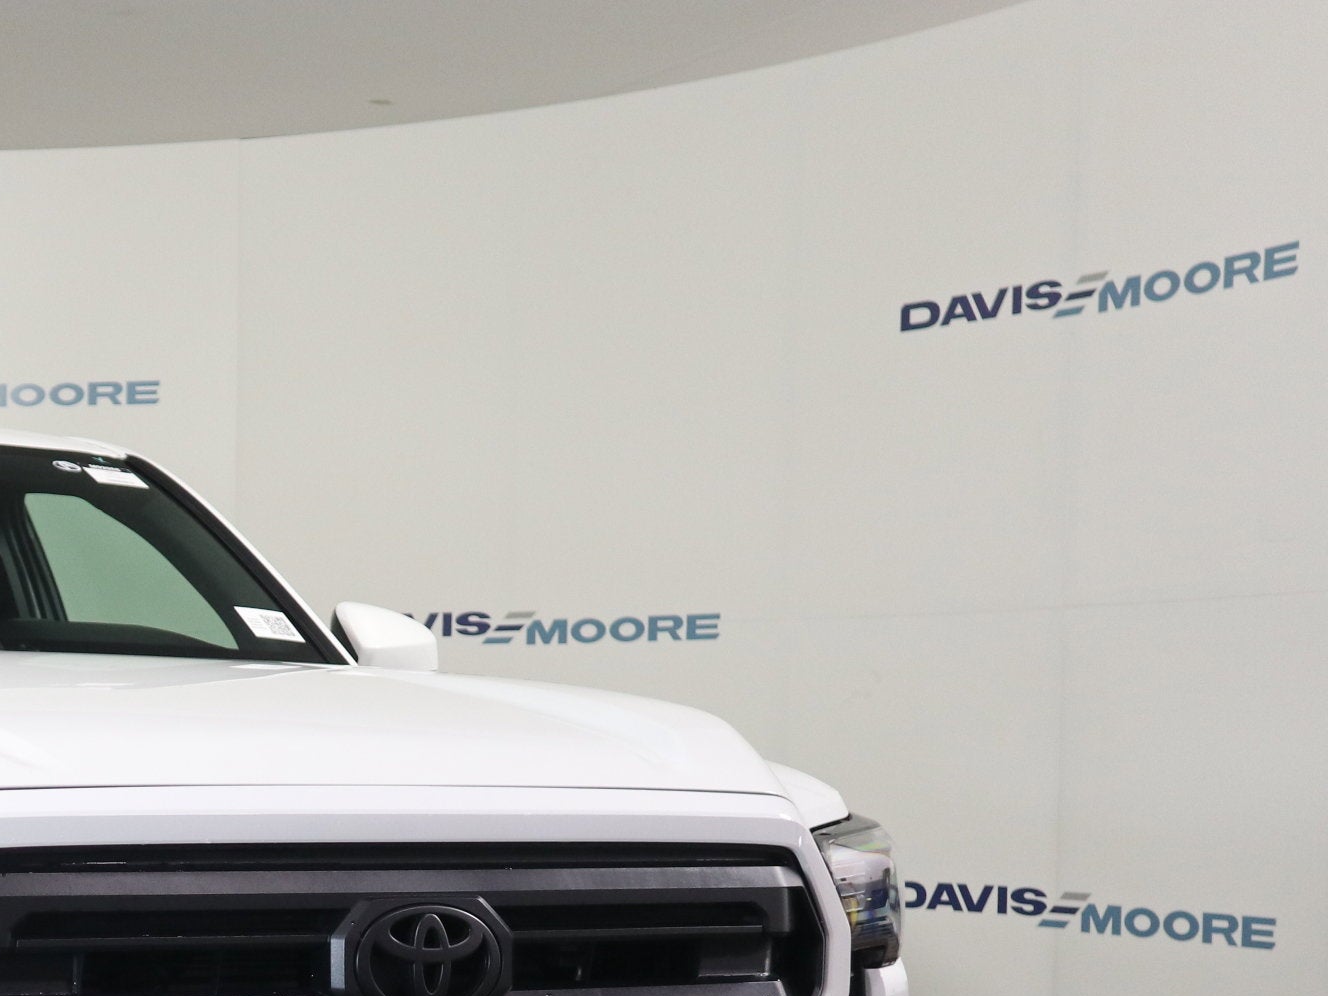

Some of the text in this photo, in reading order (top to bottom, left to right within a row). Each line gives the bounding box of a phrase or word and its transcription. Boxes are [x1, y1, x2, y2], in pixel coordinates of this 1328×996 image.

[900, 240, 1300, 333] DAVIS MOORE
[526, 613, 721, 645] MOORE
[904, 880, 1277, 950] DAVIS MOORE
